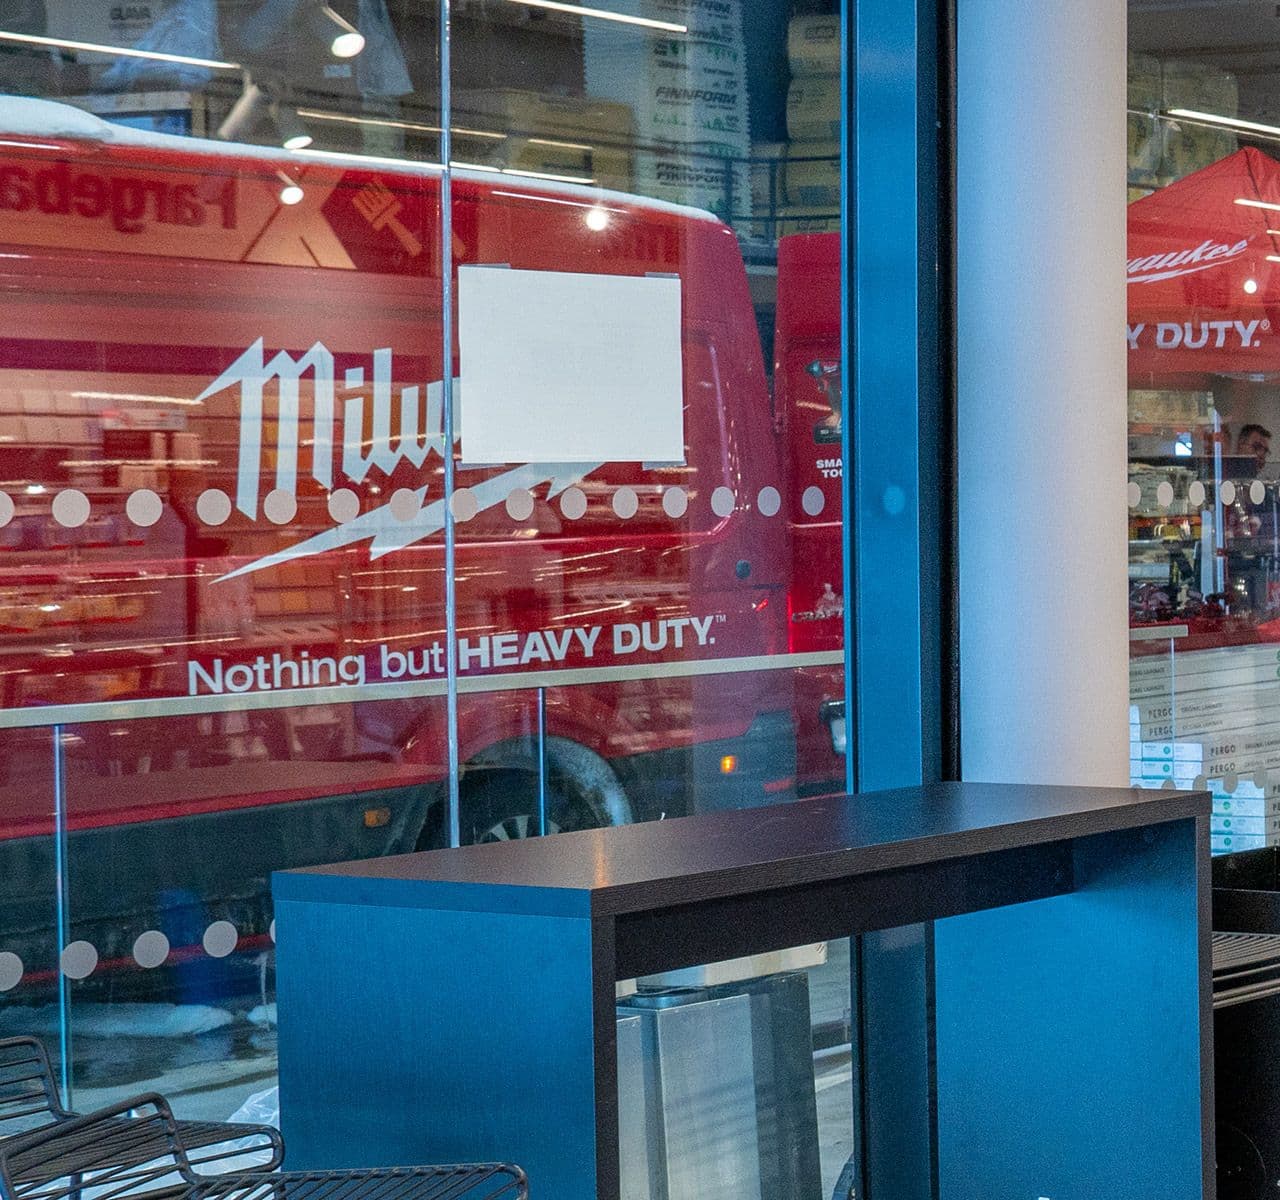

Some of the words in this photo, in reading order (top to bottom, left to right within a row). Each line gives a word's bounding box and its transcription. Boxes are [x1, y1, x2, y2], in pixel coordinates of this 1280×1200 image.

[816, 459, 842, 469] SMA
[188, 652, 366, 695] Nothing
[380, 643, 445, 680] but
[459, 626, 602, 671] HEAVY
[1210, 744, 1236, 757] PERGO
[1210, 762, 1236, 774] PERGO
